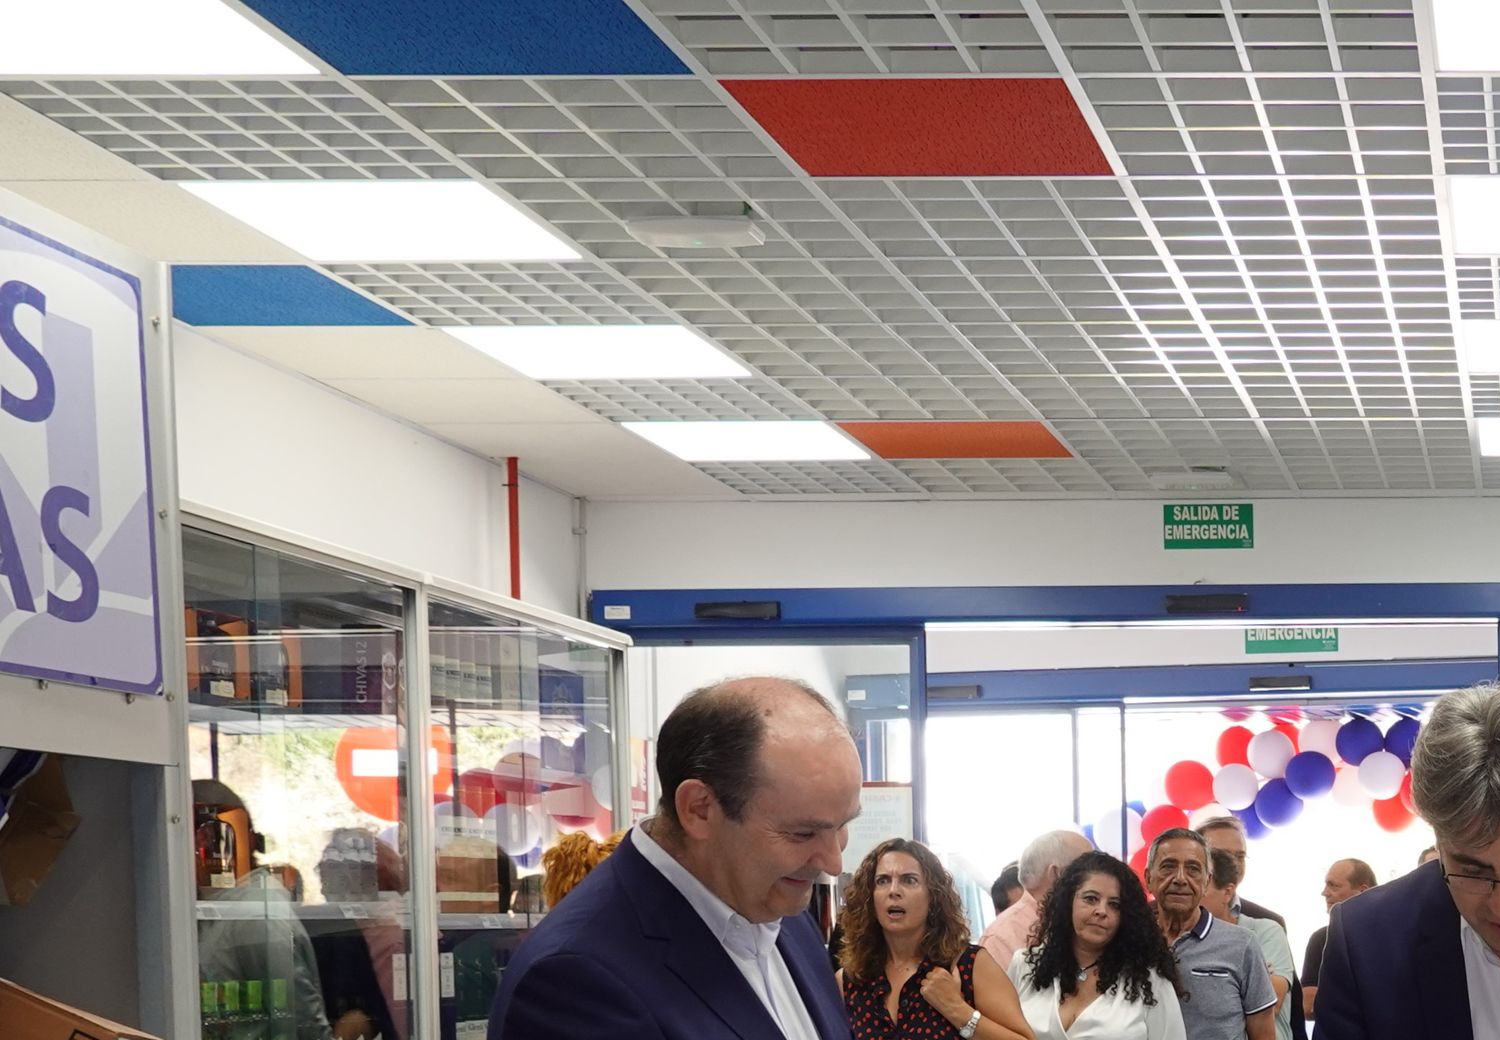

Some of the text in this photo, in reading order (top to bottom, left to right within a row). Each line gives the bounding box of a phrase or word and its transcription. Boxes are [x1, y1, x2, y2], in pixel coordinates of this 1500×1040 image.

[1173, 505, 1240, 521] SALIDA DE
[1164, 524, 1249, 540] EMERGENCIA
[1247, 628, 1336, 641] EMERGENCIA
[355, 656, 368, 703] CHIVAS
